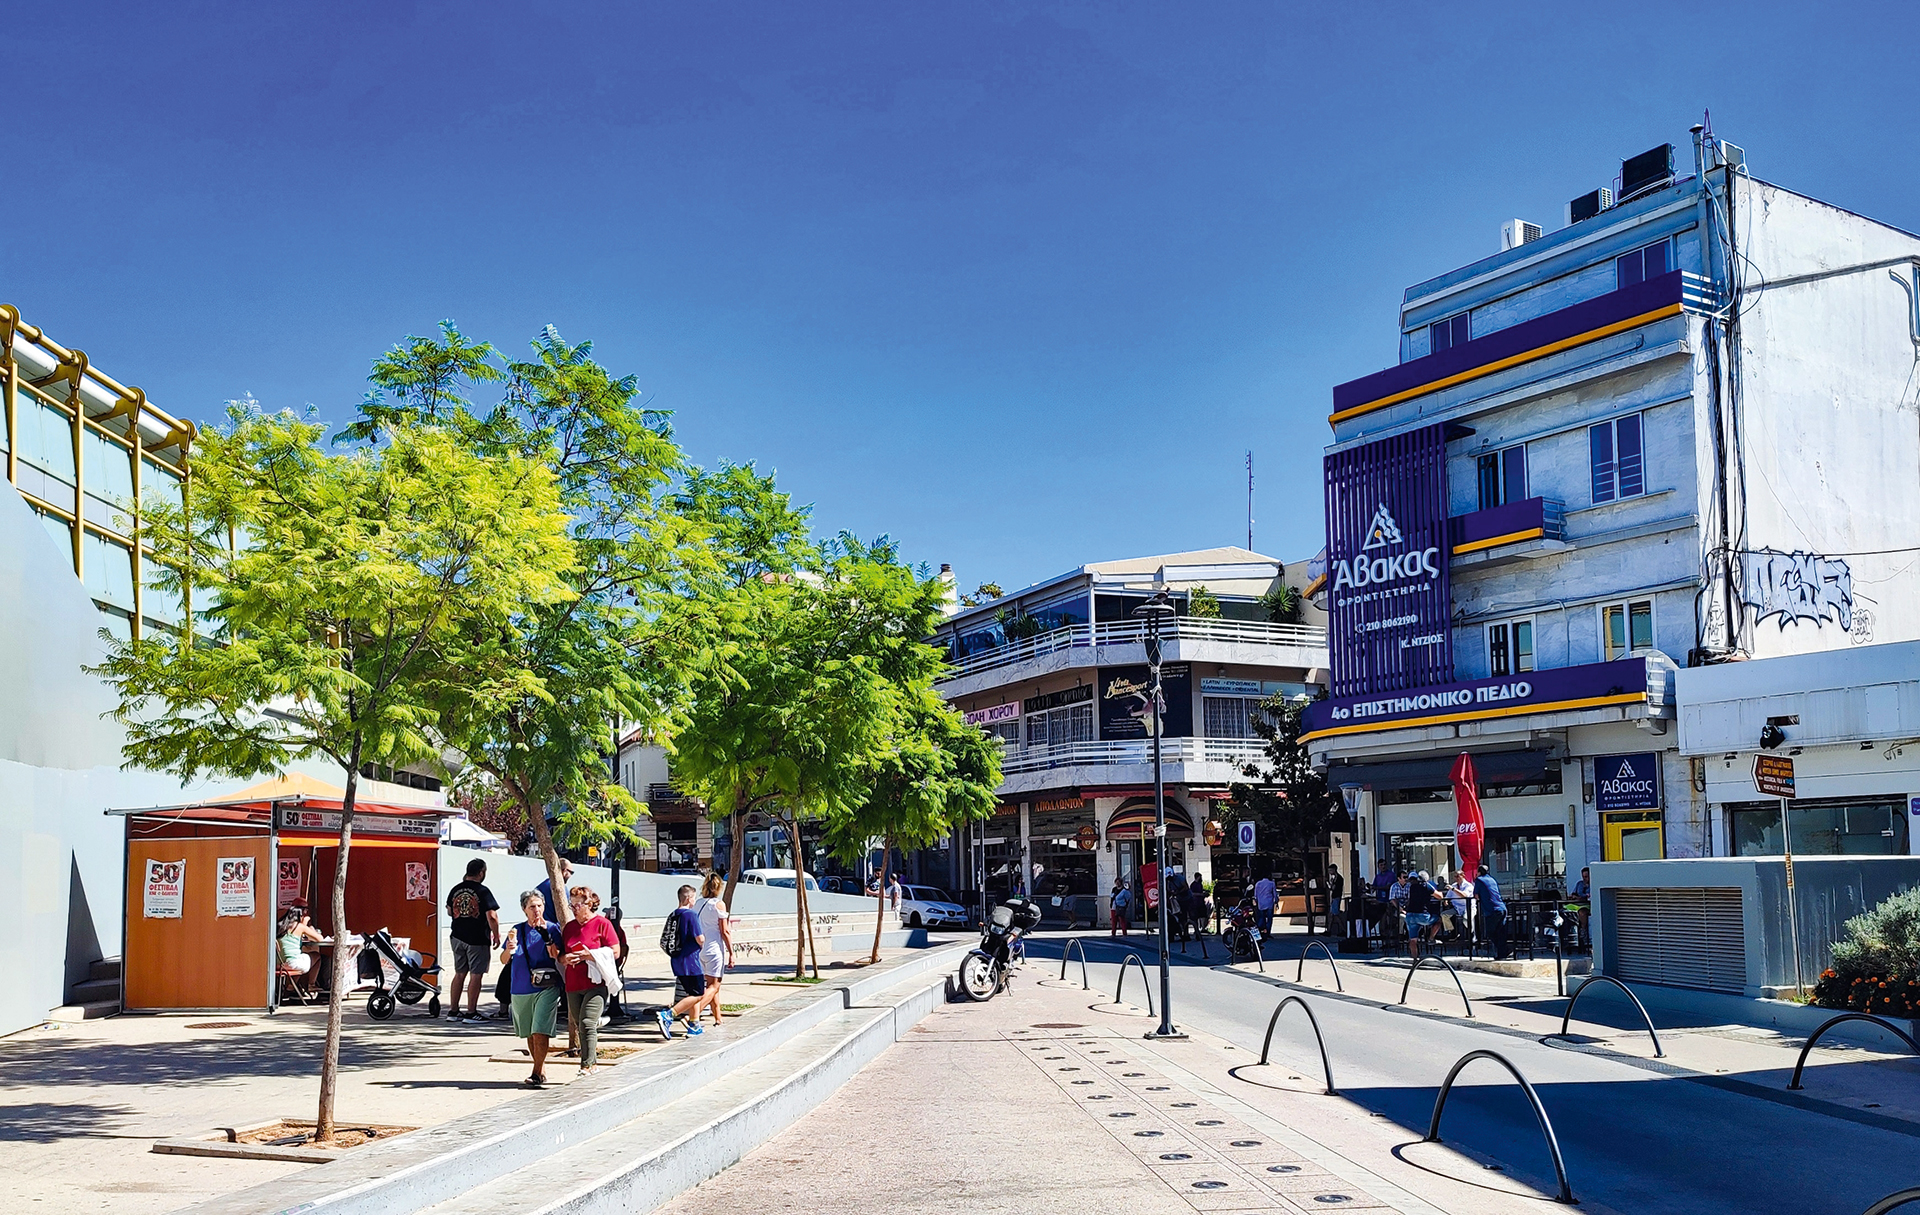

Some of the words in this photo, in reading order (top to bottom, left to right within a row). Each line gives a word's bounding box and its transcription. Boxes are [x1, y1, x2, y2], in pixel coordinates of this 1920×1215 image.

[1337, 582, 1432, 607] ΦΡΟΝΤΙΣΤΗΡΙΑ
[1366, 620, 1381, 631] 210
[1382, 614, 1419, 629] 8062190
[1411, 633, 1445, 647] ΝΤΖΙΟΣ
[1353, 689, 1474, 719] ΕΠΙΣΤΗΜΟΝΙΚΟ
[1476, 681, 1533, 703] ΠΕΔΙΟ
[988, 703, 1015, 720] ΧΟΡΟΥ
[1035, 798, 1085, 813] ΑΠΟΛΛΩΝΙΟΝ
